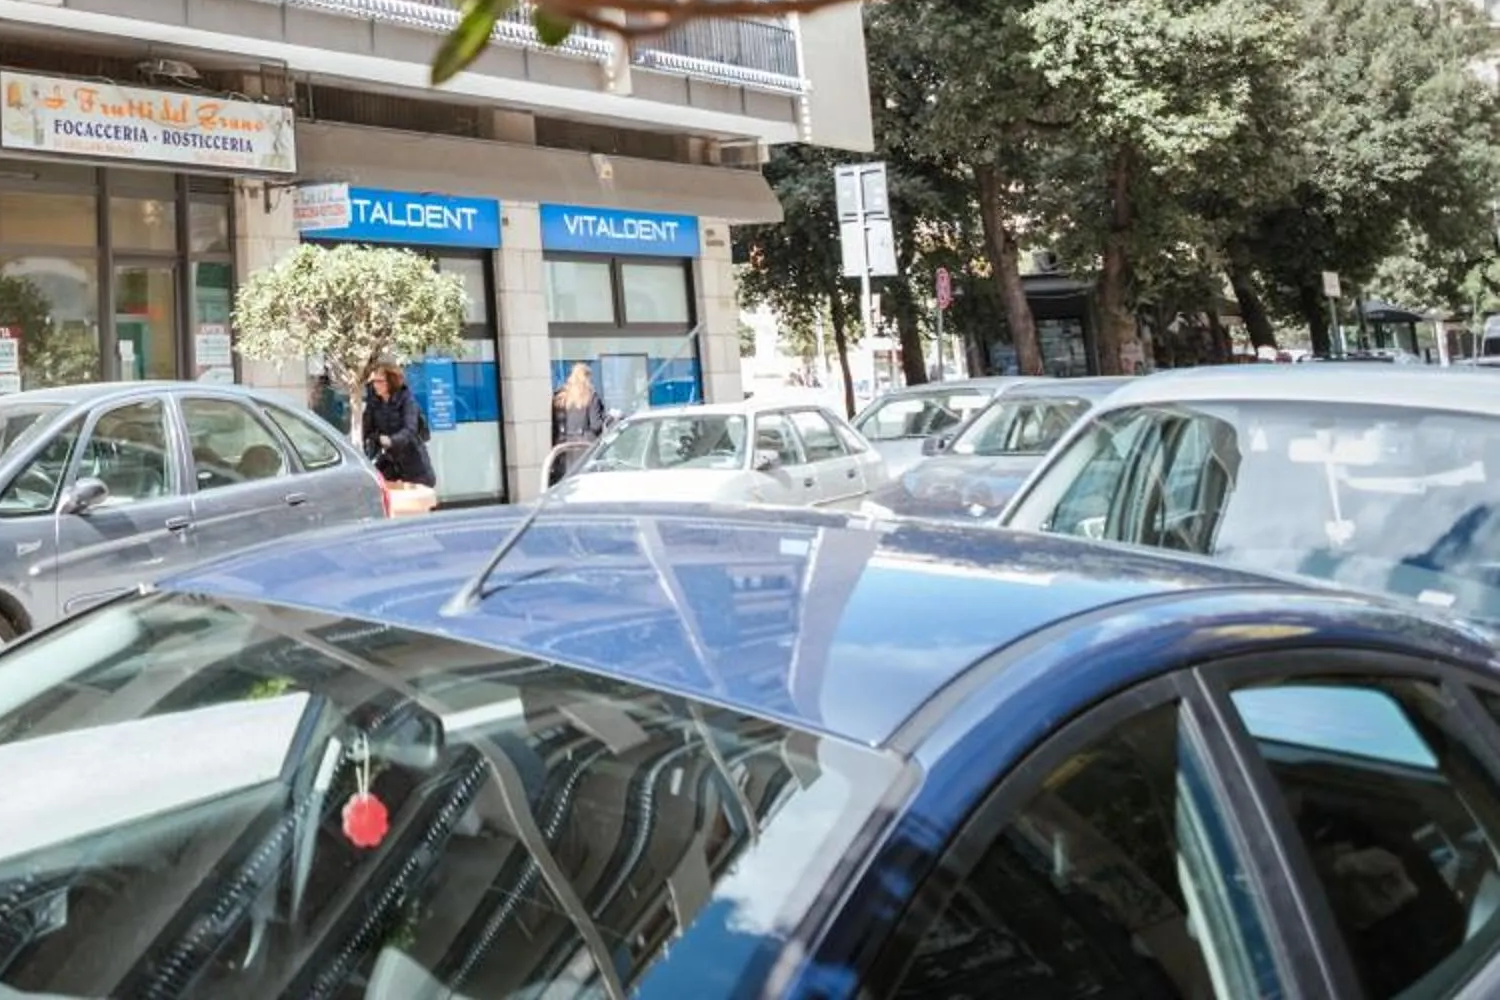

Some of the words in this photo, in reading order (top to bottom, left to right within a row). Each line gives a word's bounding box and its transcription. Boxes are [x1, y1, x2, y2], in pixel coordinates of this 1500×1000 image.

[54, 119, 148, 143] FOCACCERIA
[162, 130, 253, 153] ROSTICCERIA
[352, 199, 479, 231] TALDENT
[563, 213, 679, 243] VITALDENT
